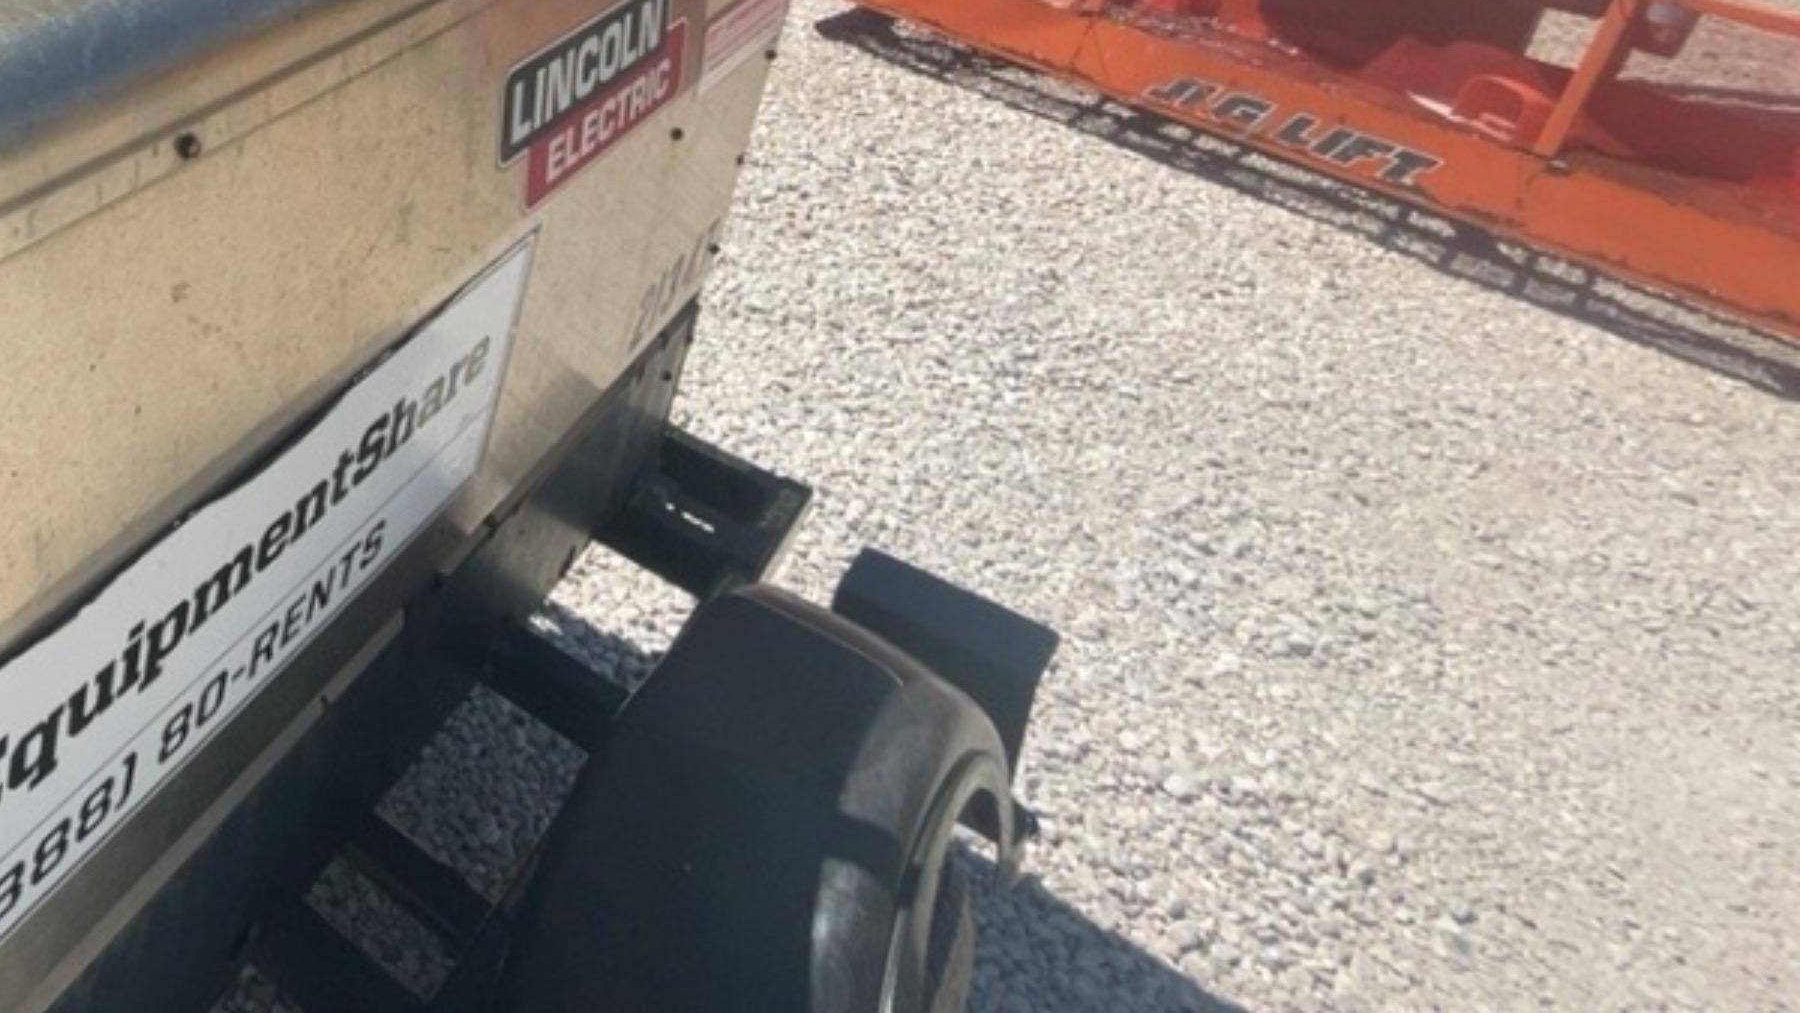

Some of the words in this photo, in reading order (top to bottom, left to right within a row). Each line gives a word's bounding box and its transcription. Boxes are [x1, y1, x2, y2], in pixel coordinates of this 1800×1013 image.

[545, 57, 672, 185] ELECTRIC
[1272, 112, 1444, 187] LIFT
[157, 519, 388, 764] 80-RENTS
